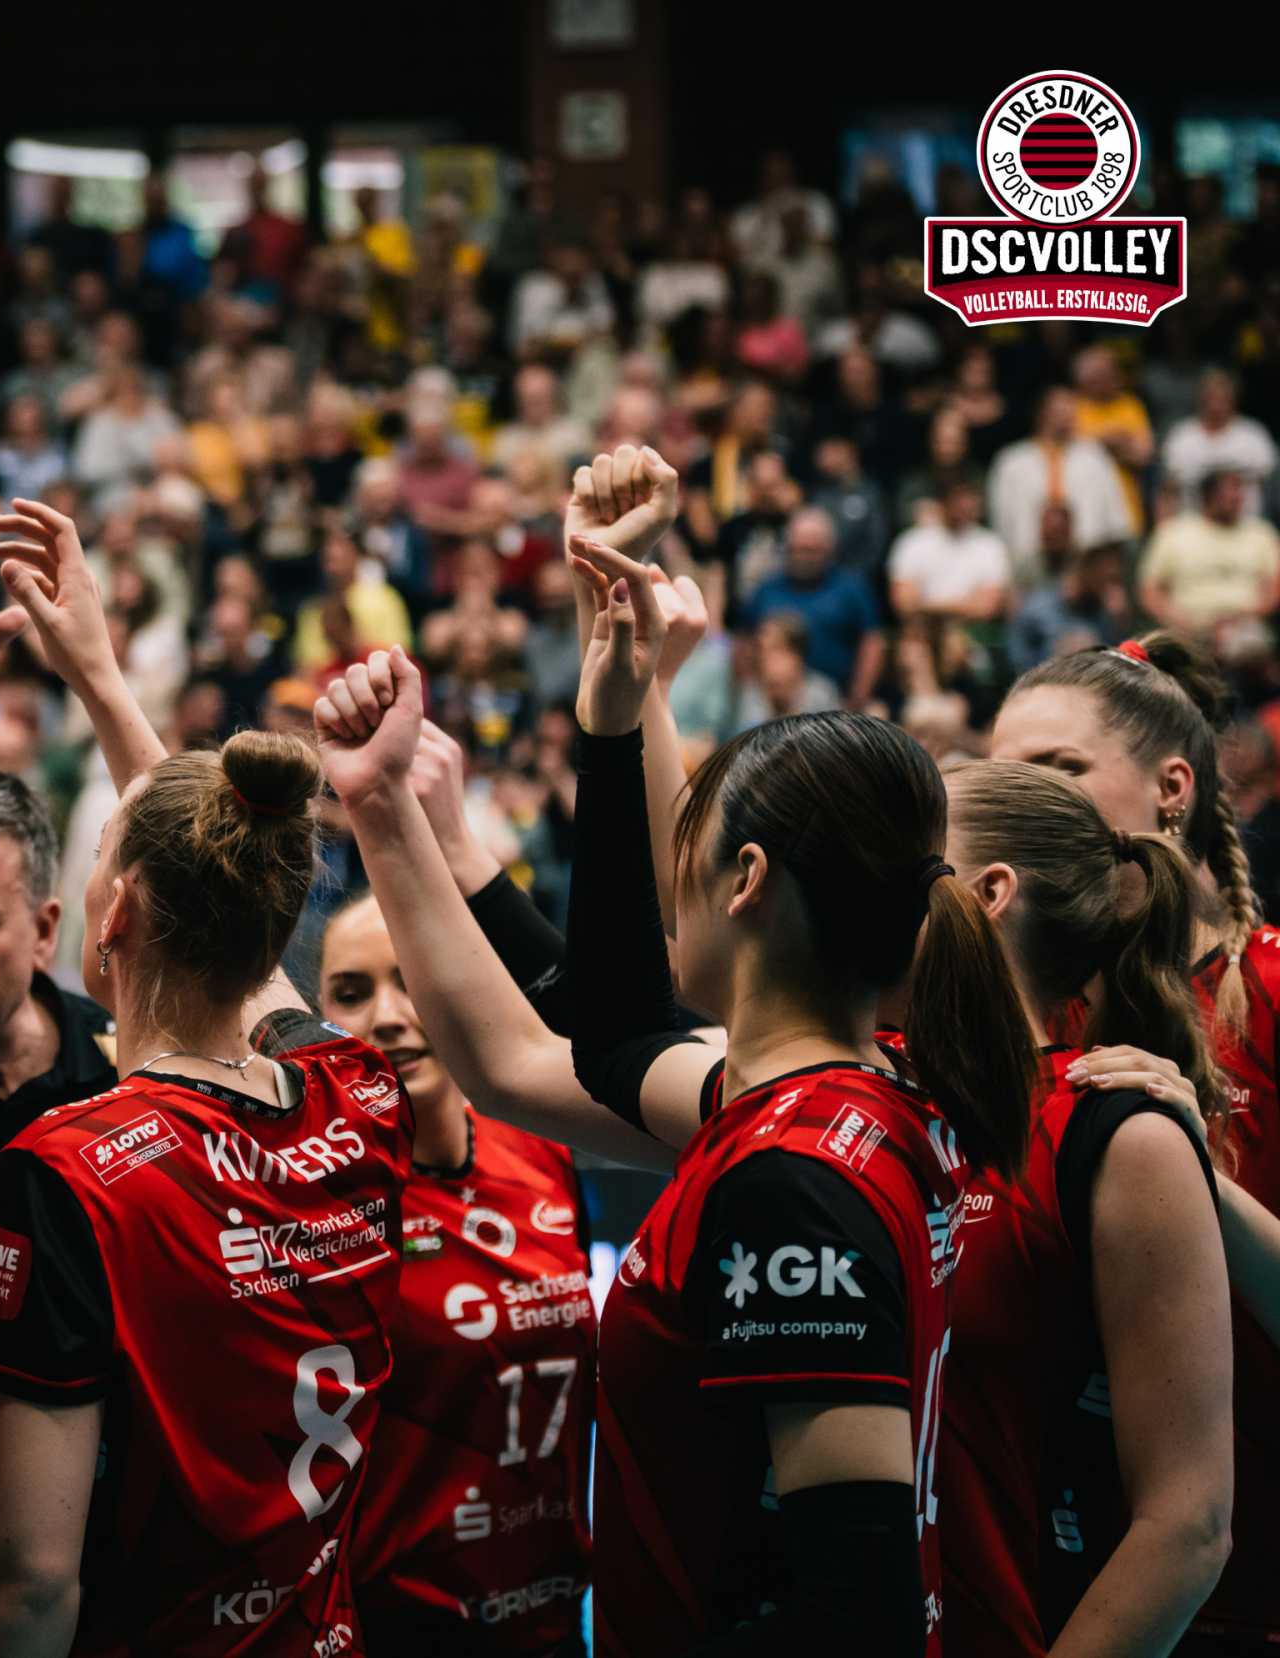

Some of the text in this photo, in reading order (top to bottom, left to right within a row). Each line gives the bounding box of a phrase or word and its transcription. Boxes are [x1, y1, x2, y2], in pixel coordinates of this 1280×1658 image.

[196, 1083, 213, 1095] 1999
[110, 1121, 159, 1153] LOTTO
[126, 1141, 171, 1168] SACHSENLOTTO
[300, 1198, 385, 1242] Sparkassen
[289, 1220, 386, 1263] Versicherung
[229, 1272, 300, 1299] Sachsen
[497, 1269, 588, 1304] Sachsen
[766, 1244, 867, 1298] GK
[507, 1296, 591, 1331] Energie
[723, 1320, 868, 1342] a Fujitsu company
[497, 1358, 577, 1467] 17
[288, 1344, 366, 1524] 8
[499, 1494, 576, 1535] Sparkas
